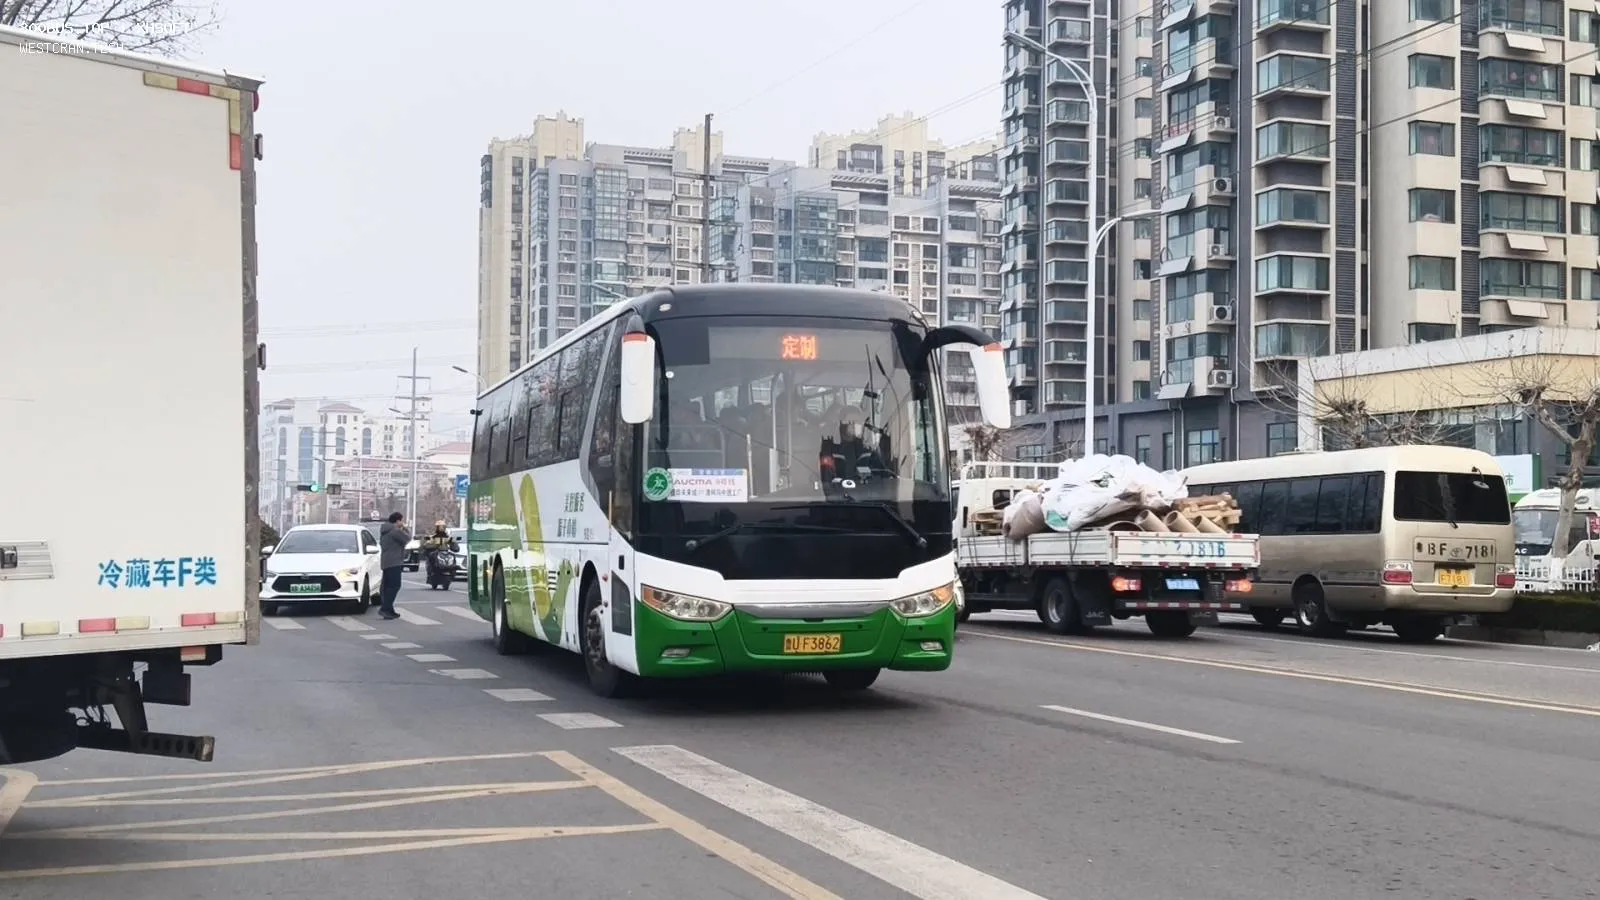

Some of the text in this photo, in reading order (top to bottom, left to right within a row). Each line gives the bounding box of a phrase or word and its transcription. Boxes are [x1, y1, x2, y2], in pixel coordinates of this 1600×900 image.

[783, 334, 816, 360] 定制
[673, 478, 712, 487] AUCMA
[1465, 544, 1494, 560] 7181
[97, 555, 217, 589] 冷藏车F类
